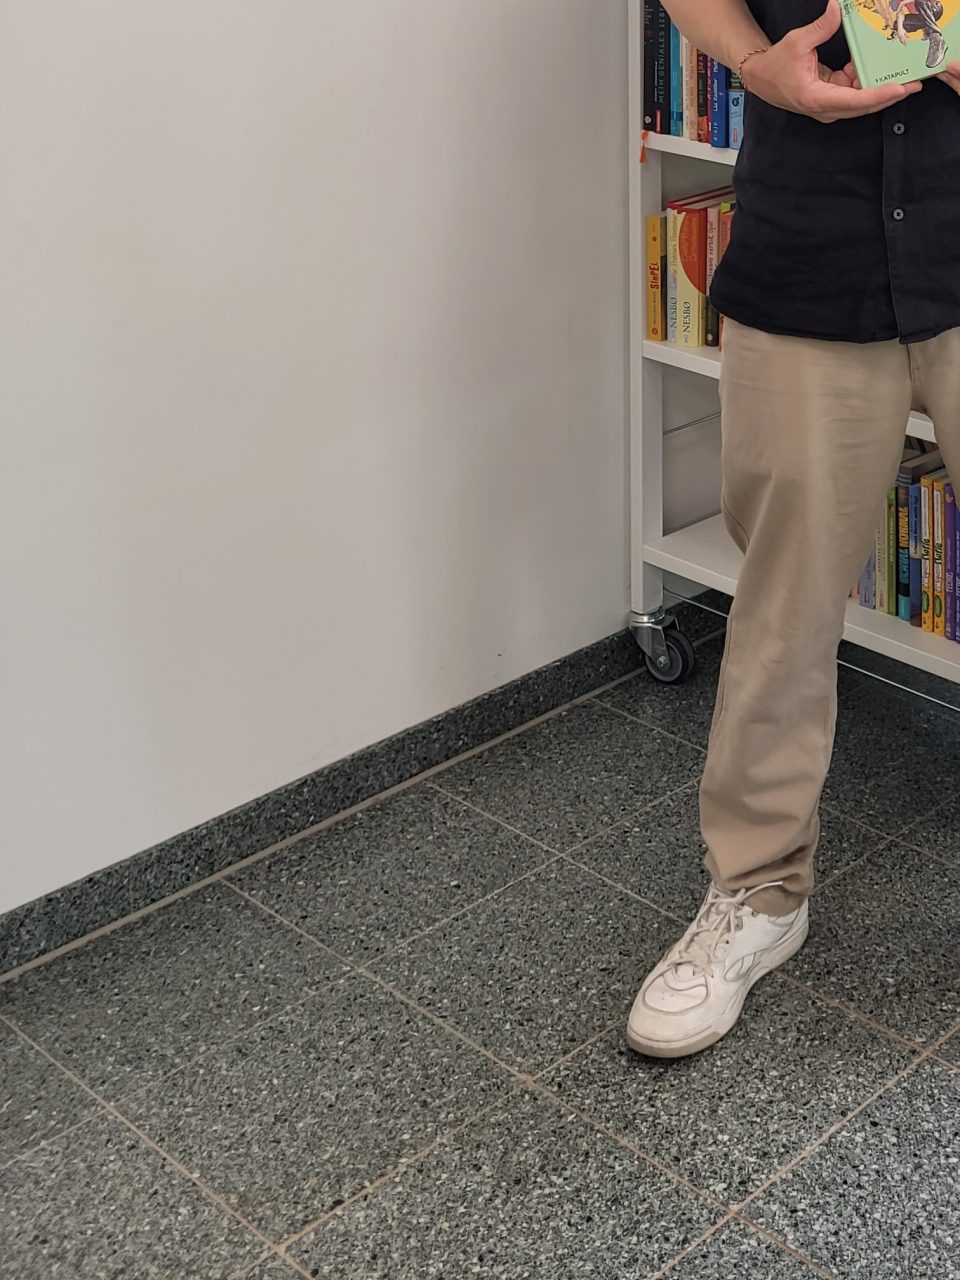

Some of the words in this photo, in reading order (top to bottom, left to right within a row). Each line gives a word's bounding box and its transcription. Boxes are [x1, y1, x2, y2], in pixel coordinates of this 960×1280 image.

[879, 69, 910, 84] KATAPULT
[683, 301, 691, 333] NESBØ
[898, 507, 909, 547] NORMAL
